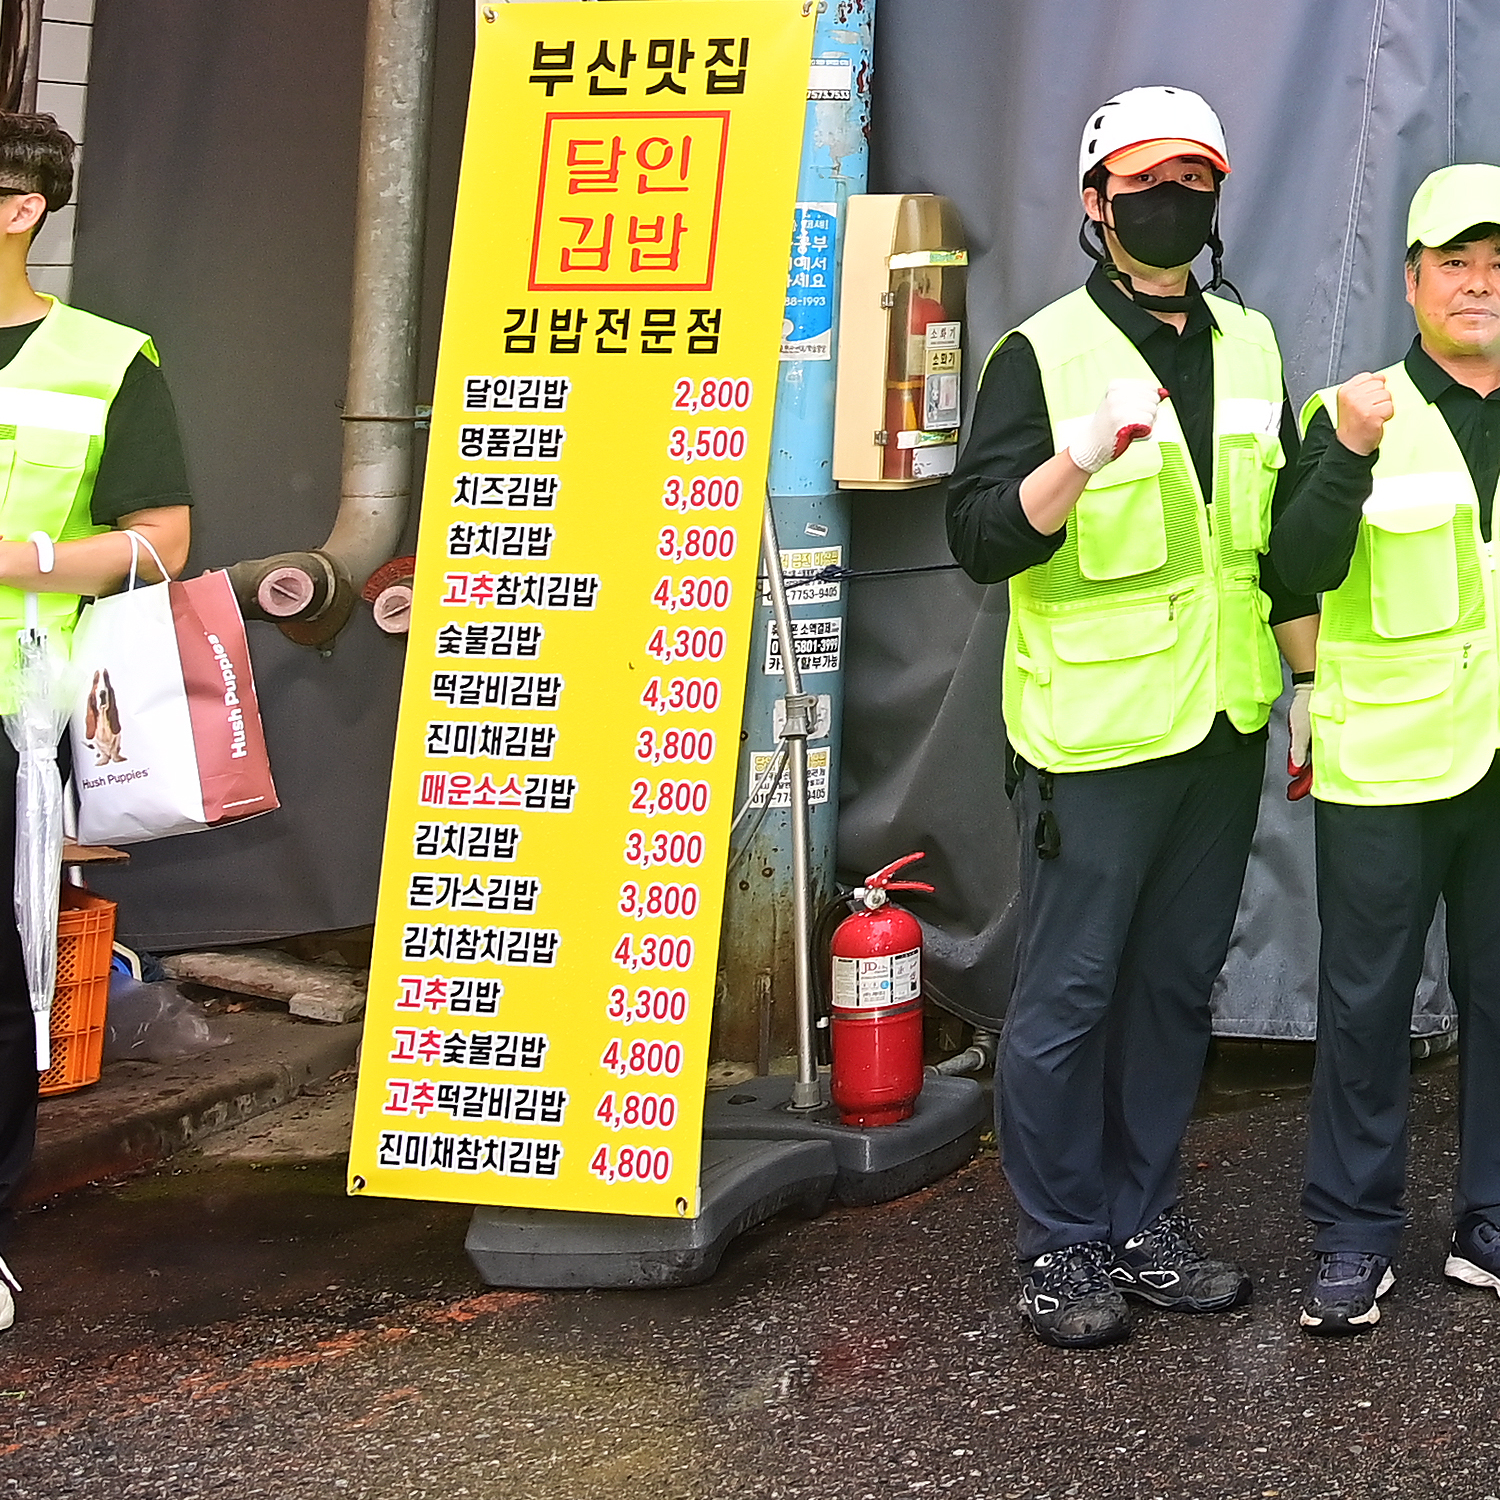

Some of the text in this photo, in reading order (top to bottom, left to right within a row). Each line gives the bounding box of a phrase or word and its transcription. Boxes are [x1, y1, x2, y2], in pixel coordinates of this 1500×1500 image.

[529, 38, 750, 96] 부산맛집
[566, 135, 693, 195] 달인
[558, 212, 688, 273] 김밥
[503, 308, 722, 355] 김밥전문점
[465, 378, 750, 412] 달인김밥 2,800
[460, 427, 744, 461] 명품김밥 3,500
[454, 476, 740, 511] 치즈김밥 3,800
[449, 525, 735, 561] 참치김밥 3,800
[443, 574, 598, 608] 고추참치김밥
[654, 579, 729, 611] 4,300
[438, 624, 724, 662] 숯불김밥 4,300
[204, 633, 248, 759] Hush Puppies
[433, 674, 719, 713] 떡갈비김밥 4,300
[426, 723, 714, 764] 진미채김밥 3,800
[82, 768, 149, 791] Hush Puppies
[420, 774, 708, 816] 매운소스김밥 2,800
[415, 824, 702, 868] 김치김밥 3,300
[409, 876, 697, 920] 돈가스김밥 3,800
[403, 927, 691, 971] 김치참치김밥 4,300
[397, 979, 686, 1025] 고추김밥 3,300
[391, 1030, 680, 1076] 고추숯불김밥 4,800
[385, 1081, 675, 1129] 고추떡갈비김밥 4,800
[378, 1133, 670, 1183] 진미채참치김밥 4,800
